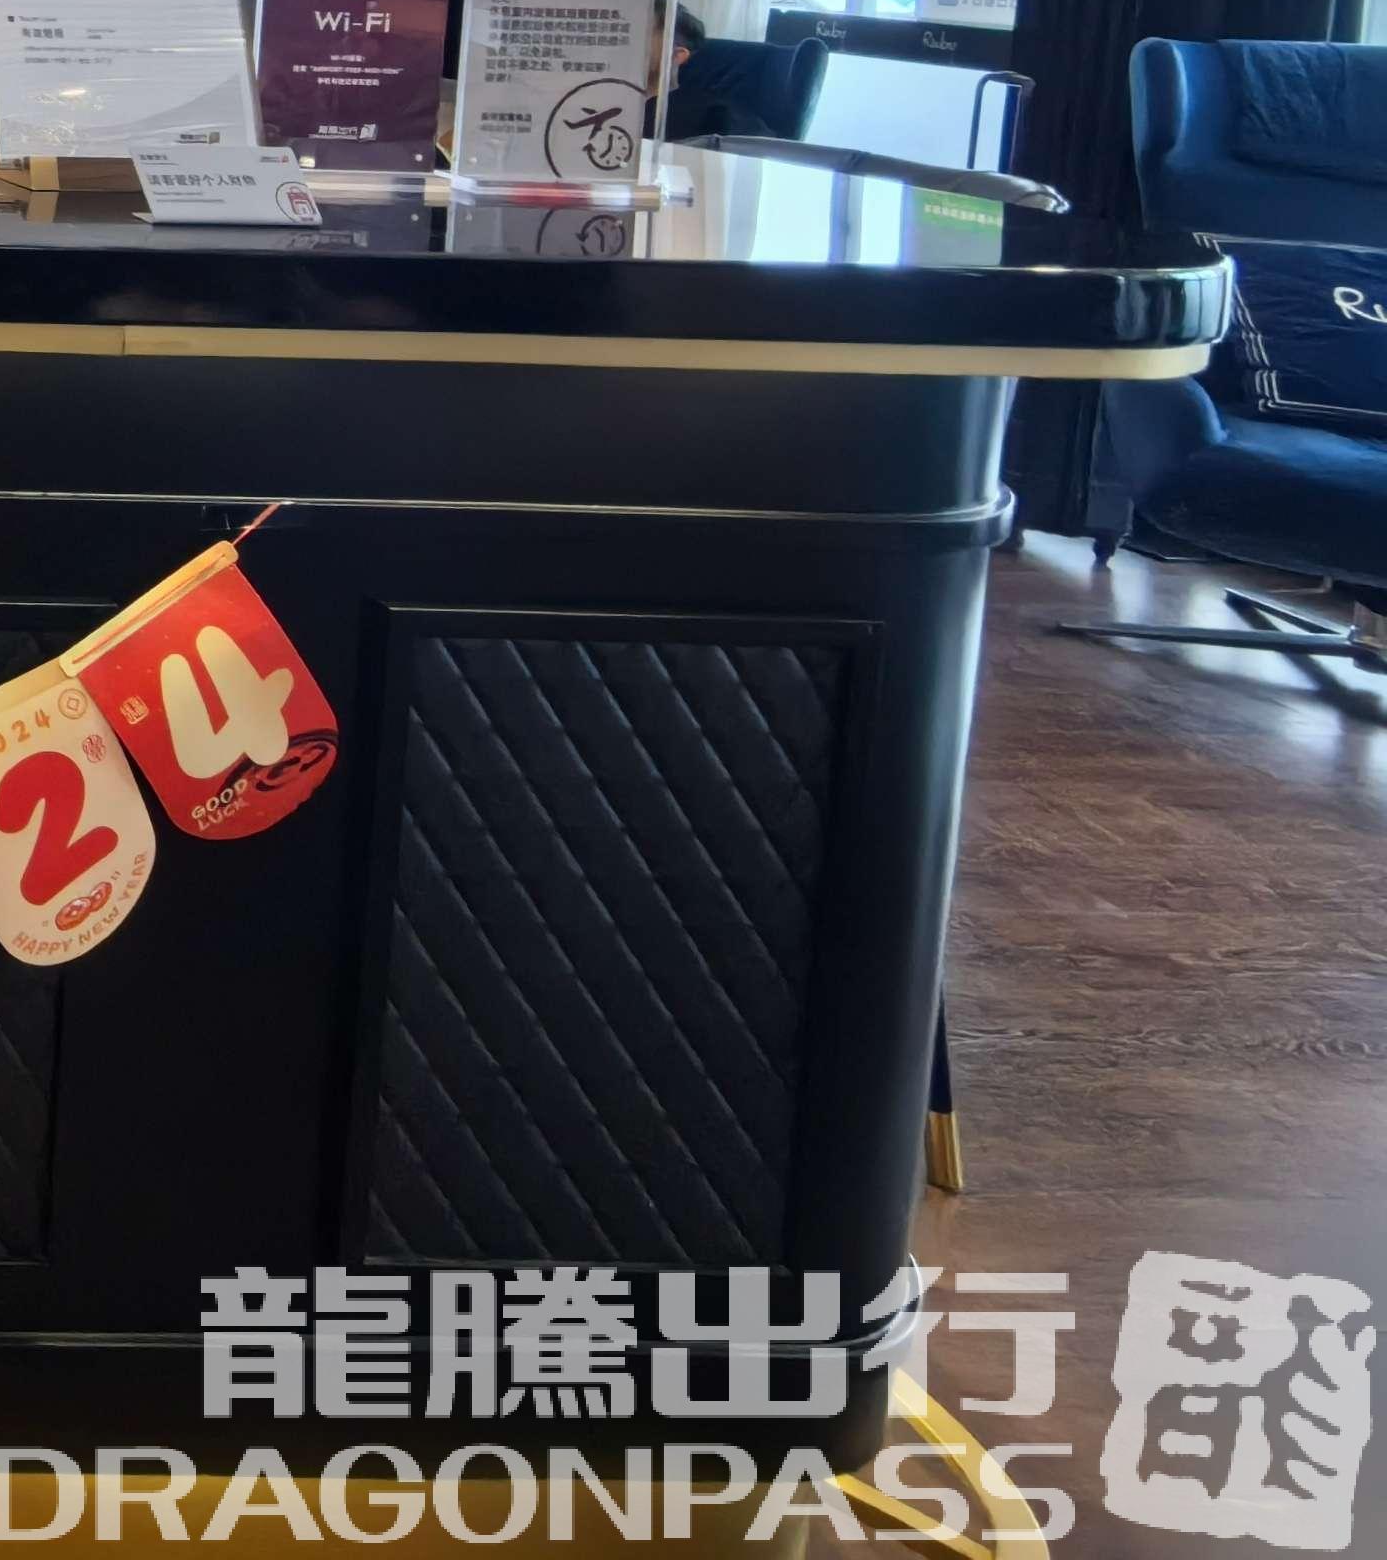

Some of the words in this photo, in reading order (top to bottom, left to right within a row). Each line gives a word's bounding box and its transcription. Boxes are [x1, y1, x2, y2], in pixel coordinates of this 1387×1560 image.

[314, 10, 392, 33] Wi-Fi
[160, 625, 295, 780] 4
[191, 778, 249, 820] GOOD
[10, 930, 74, 957] HAPPY
[78, 905, 122, 947] NEW
[117, 849, 149, 905] YEAR
